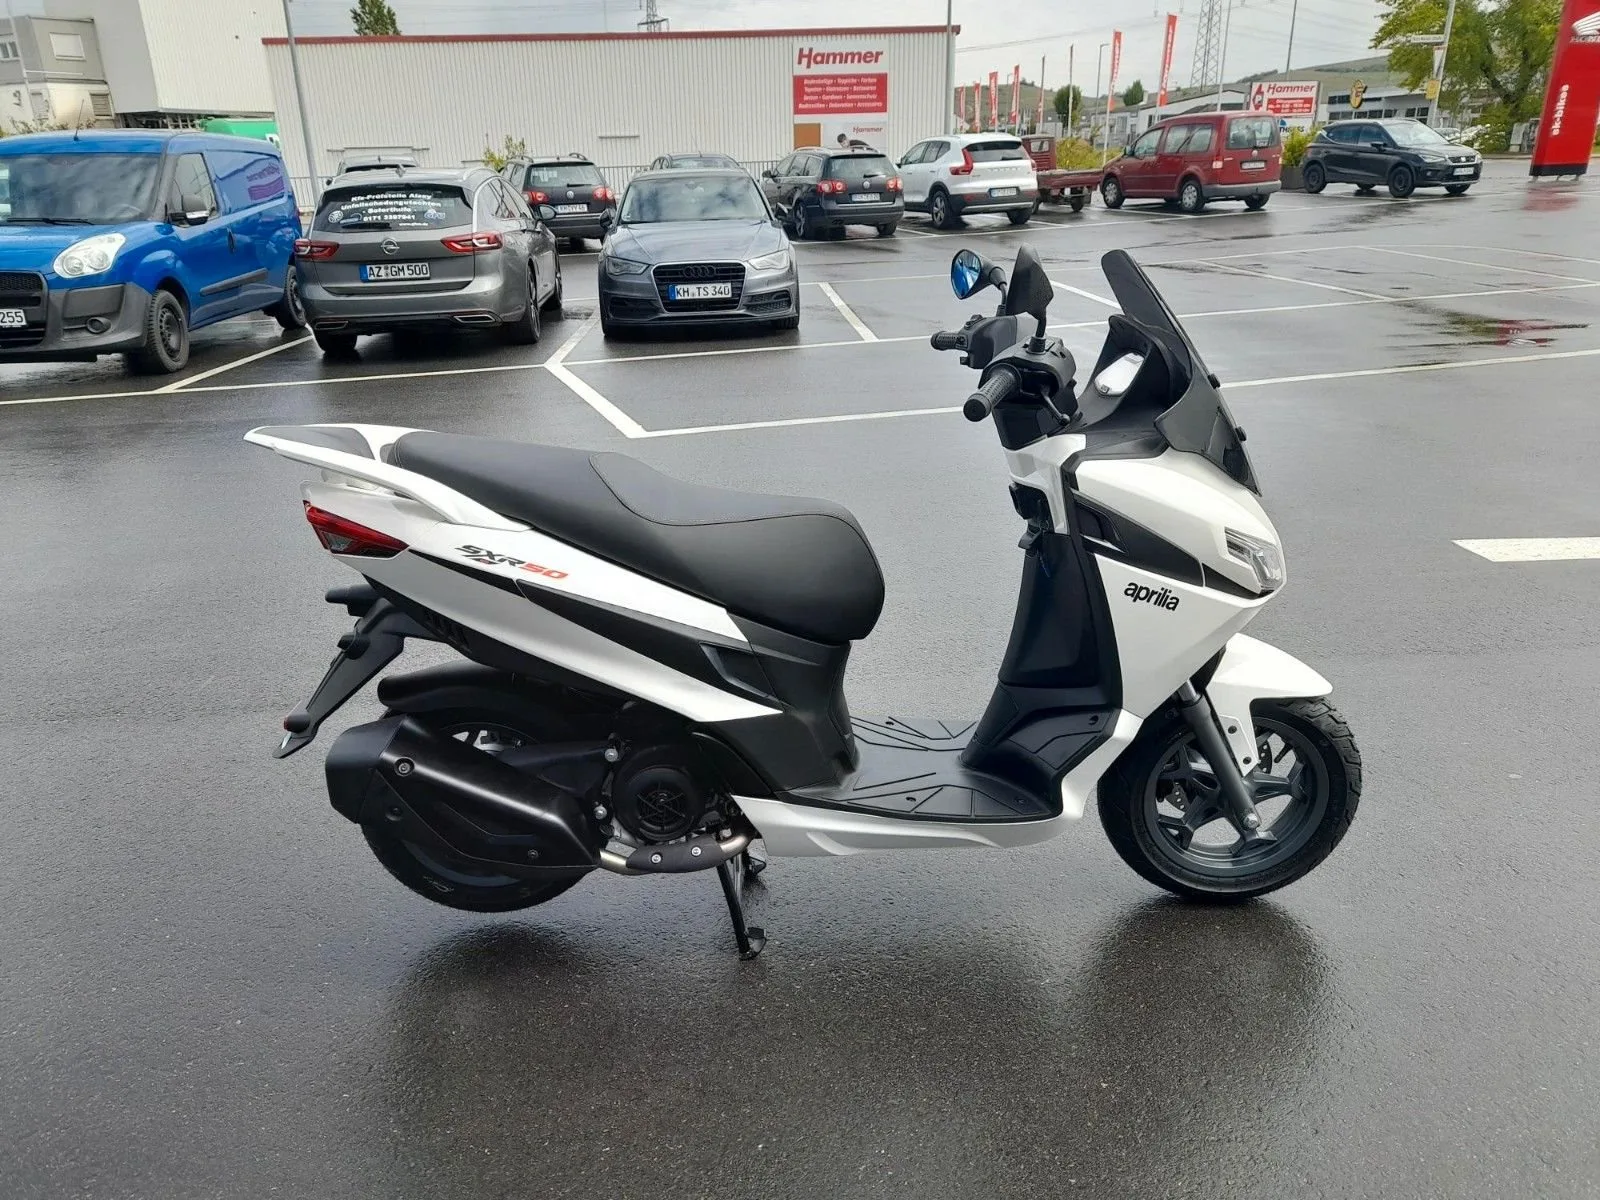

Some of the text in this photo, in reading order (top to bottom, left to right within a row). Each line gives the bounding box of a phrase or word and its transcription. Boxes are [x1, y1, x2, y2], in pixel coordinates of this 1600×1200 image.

[1569, 34, 1600, 44] HON
[797, 47, 884, 69] Hammer
[1267, 84, 1315, 94] Hammer
[368, 264, 429, 278] AZ GM 500
[676, 285, 730, 298] KH TS 340
[1123, 581, 1180, 612] aprilia
